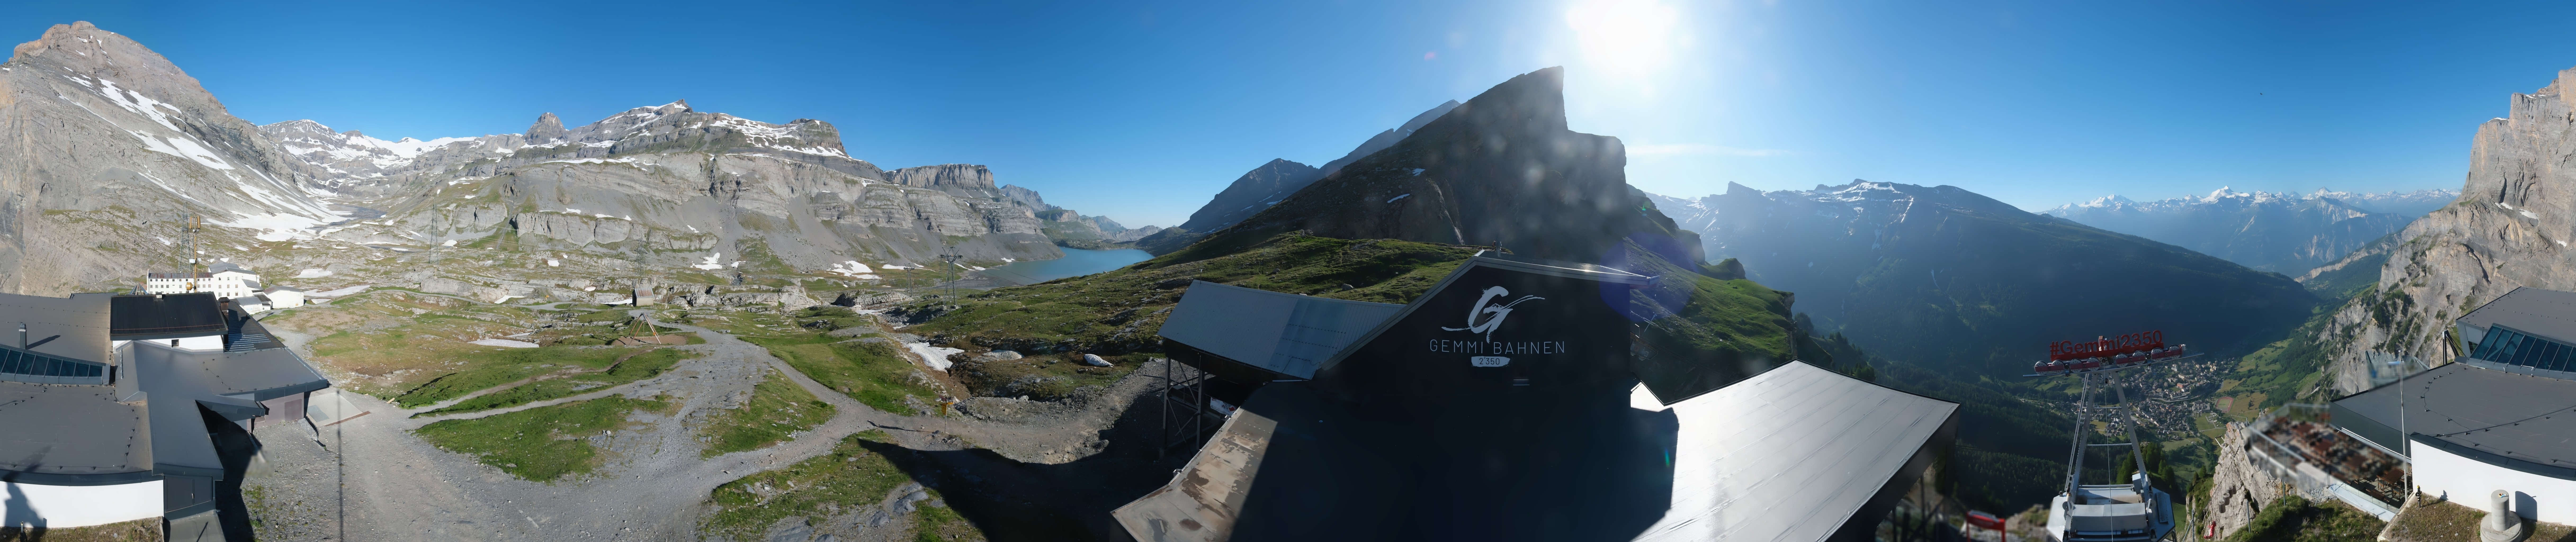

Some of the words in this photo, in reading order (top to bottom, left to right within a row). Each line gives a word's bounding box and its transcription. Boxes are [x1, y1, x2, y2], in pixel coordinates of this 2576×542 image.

[1430, 339, 1483, 354] GEMMI
[1494, 341, 1564, 354] BAHNEN
[2049, 330, 2162, 355] #Gemmi2350
